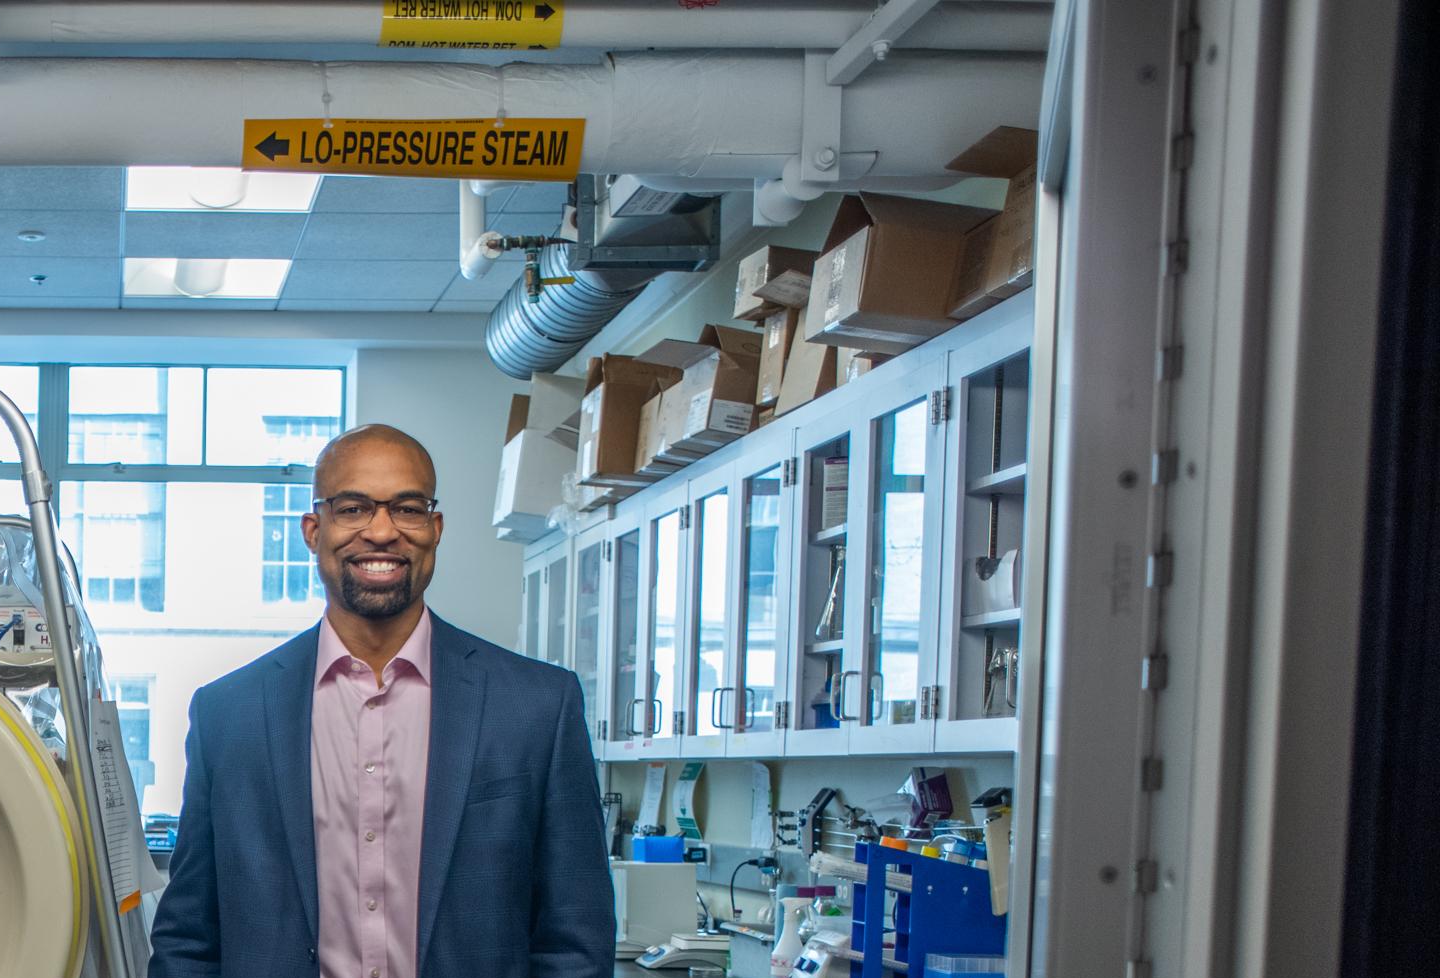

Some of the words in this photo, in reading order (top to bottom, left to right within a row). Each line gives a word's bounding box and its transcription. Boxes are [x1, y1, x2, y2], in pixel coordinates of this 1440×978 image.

[420, 0, 461, 20] WATER
[464, 0, 489, 20] HOT
[300, 130, 476, 166] LO-PRESSURE
[481, 130, 569, 167] STEAM
